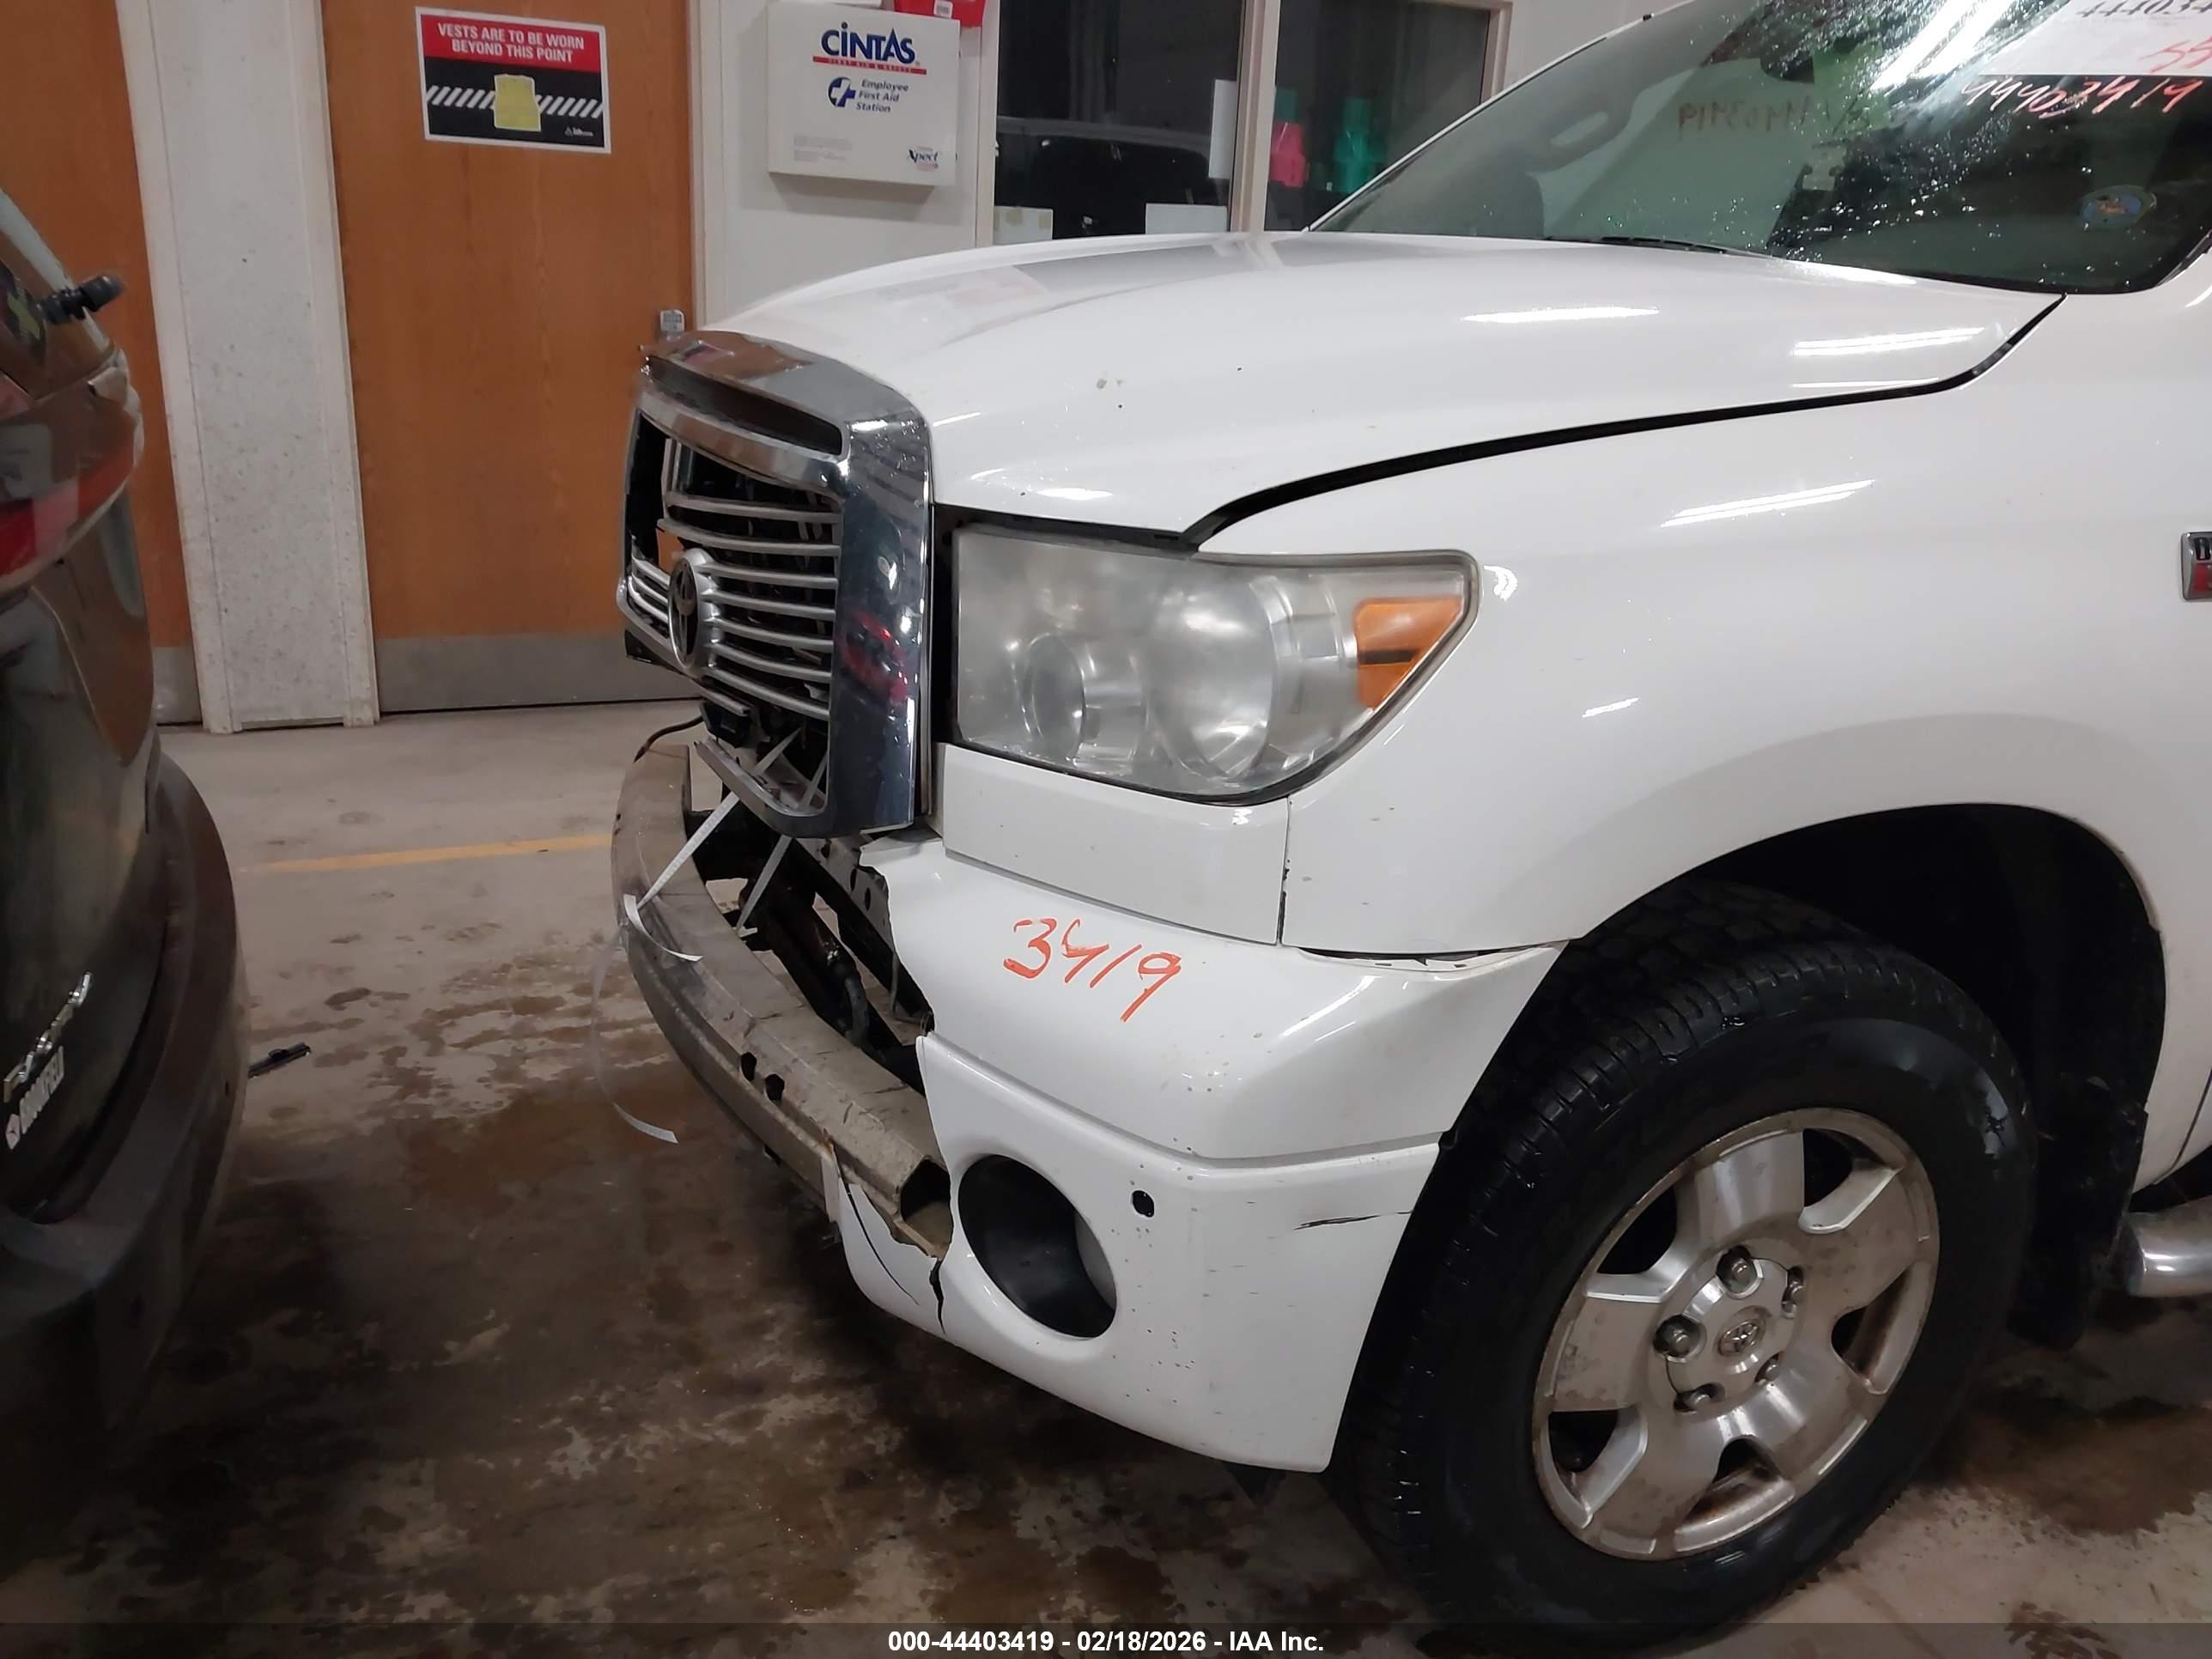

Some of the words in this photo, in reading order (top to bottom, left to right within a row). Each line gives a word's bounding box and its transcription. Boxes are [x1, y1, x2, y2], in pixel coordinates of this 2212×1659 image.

[437, 22, 478, 40] VESTS
[481, 27, 506, 42] ARE
[508, 30, 525, 44] TO
[527, 32, 544, 46] BE
[546, 33, 585, 50] WORN
[452, 39, 503, 57] BEYOND
[507, 44, 534, 59] THIS
[536, 47, 574, 63] POINT
[861, 78, 909, 92] Employee
[859, 90, 880, 101] First
[882, 92, 900, 102] Aid
[856, 102, 891, 113] Station
[1003, 918, 1182, 1022] 3419
